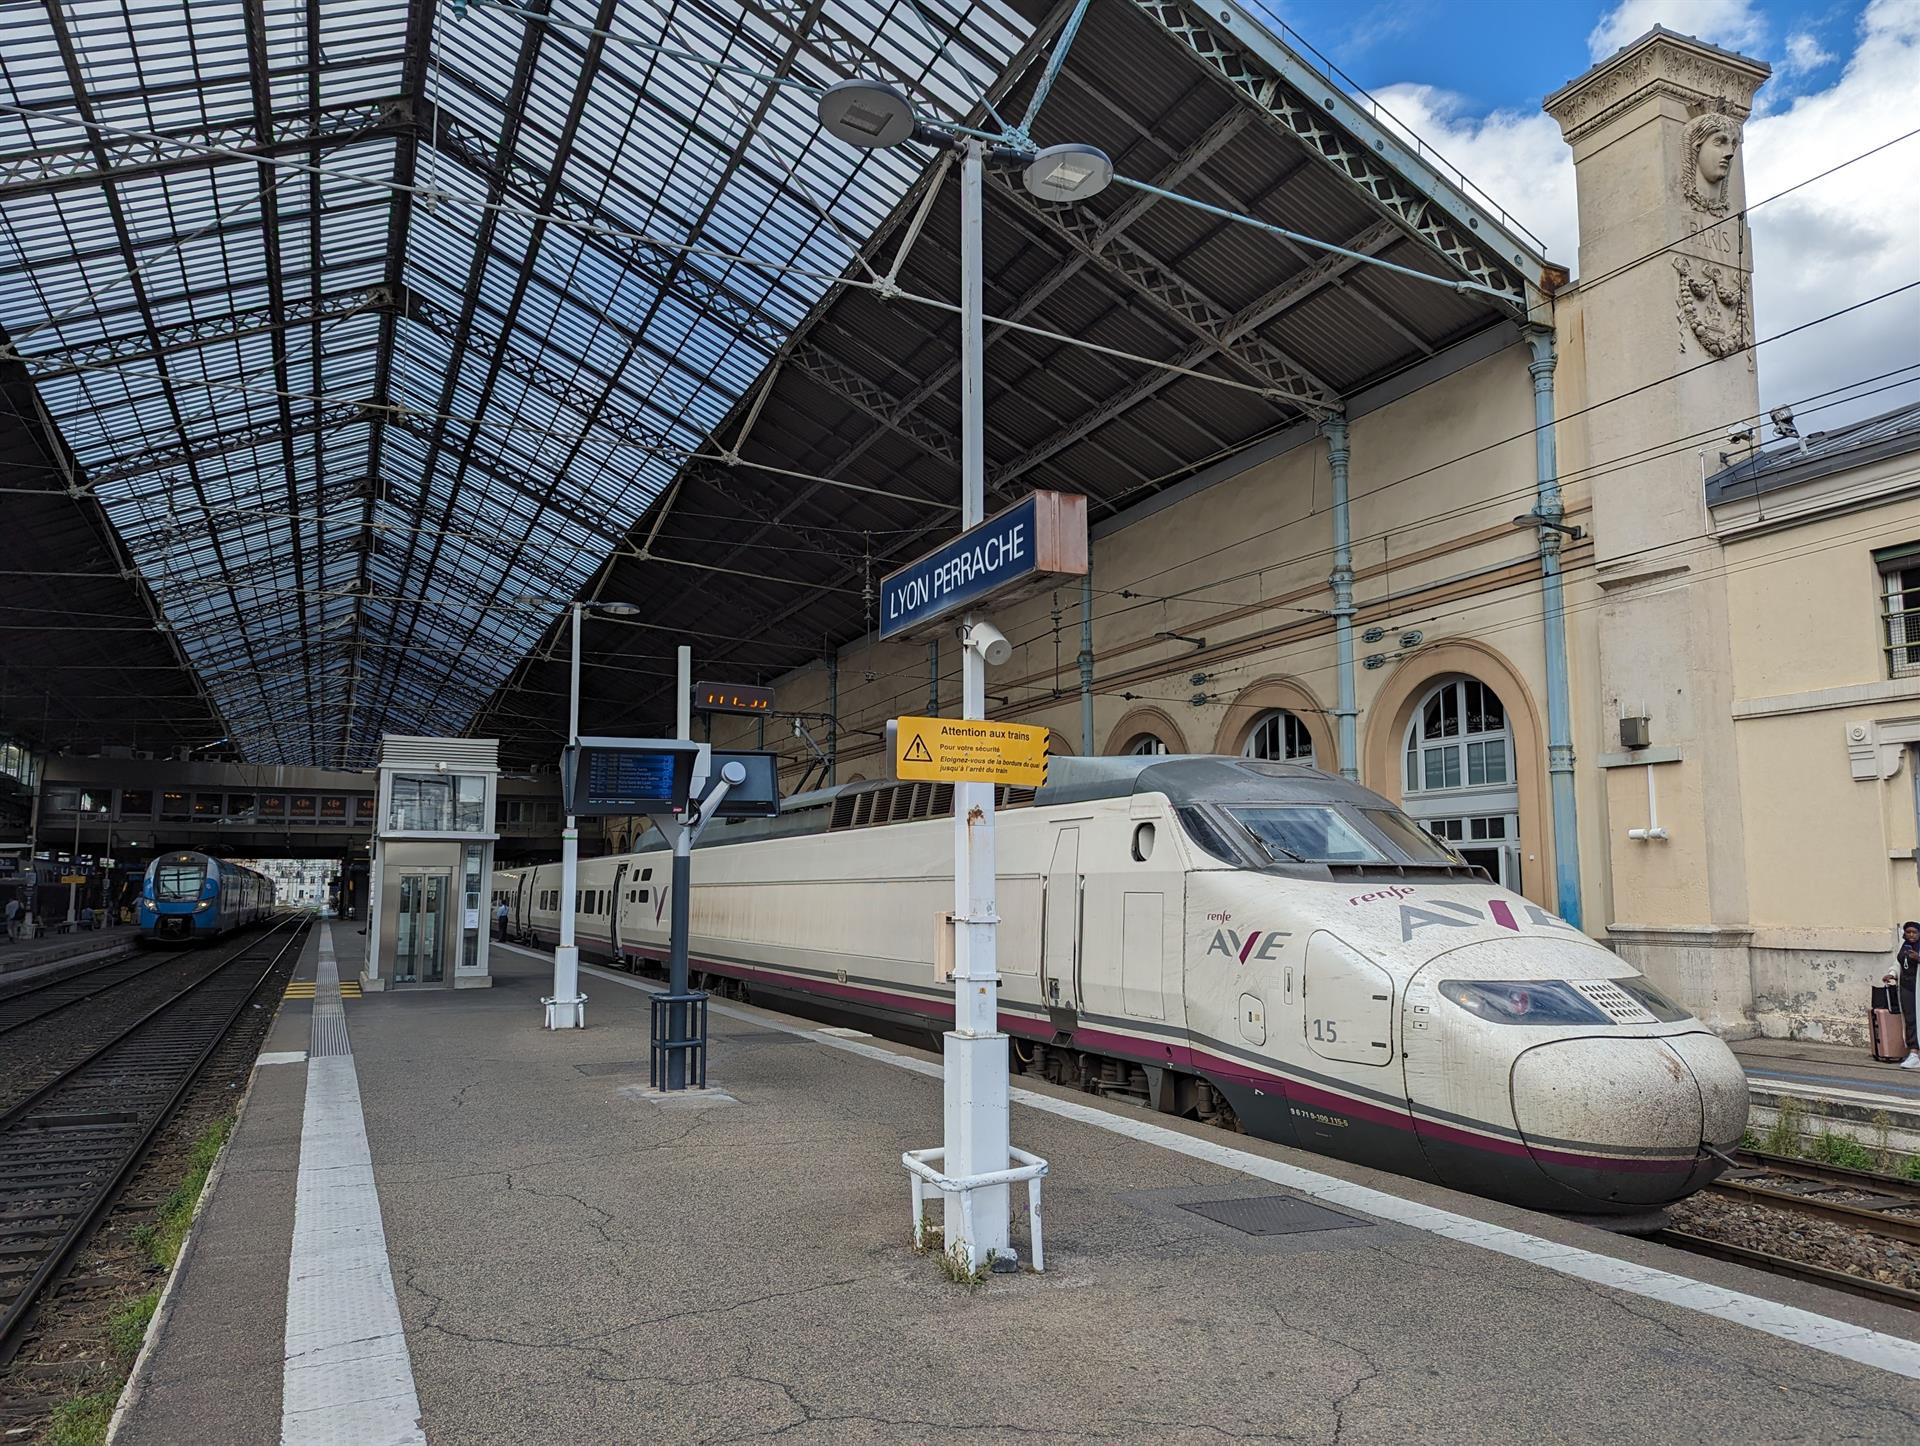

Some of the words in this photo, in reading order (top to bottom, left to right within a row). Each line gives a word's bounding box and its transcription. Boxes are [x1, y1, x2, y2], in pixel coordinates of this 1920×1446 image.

[890, 574, 929, 619] LYON
[934, 523, 1024, 599] PERRACHE
[941, 726, 987, 737] Attention
[989, 730, 1006, 739] aux
[1008, 731, 1030, 741] trains
[975, 745, 1000, 753] sécurité
[1349, 885, 1415, 906] renfe
[1207, 910, 1232, 924] renfe
[1399, 899, 1577, 943] AVE
[1206, 928, 1293, 966] AVE
[1313, 1018, 1338, 1043] 15
